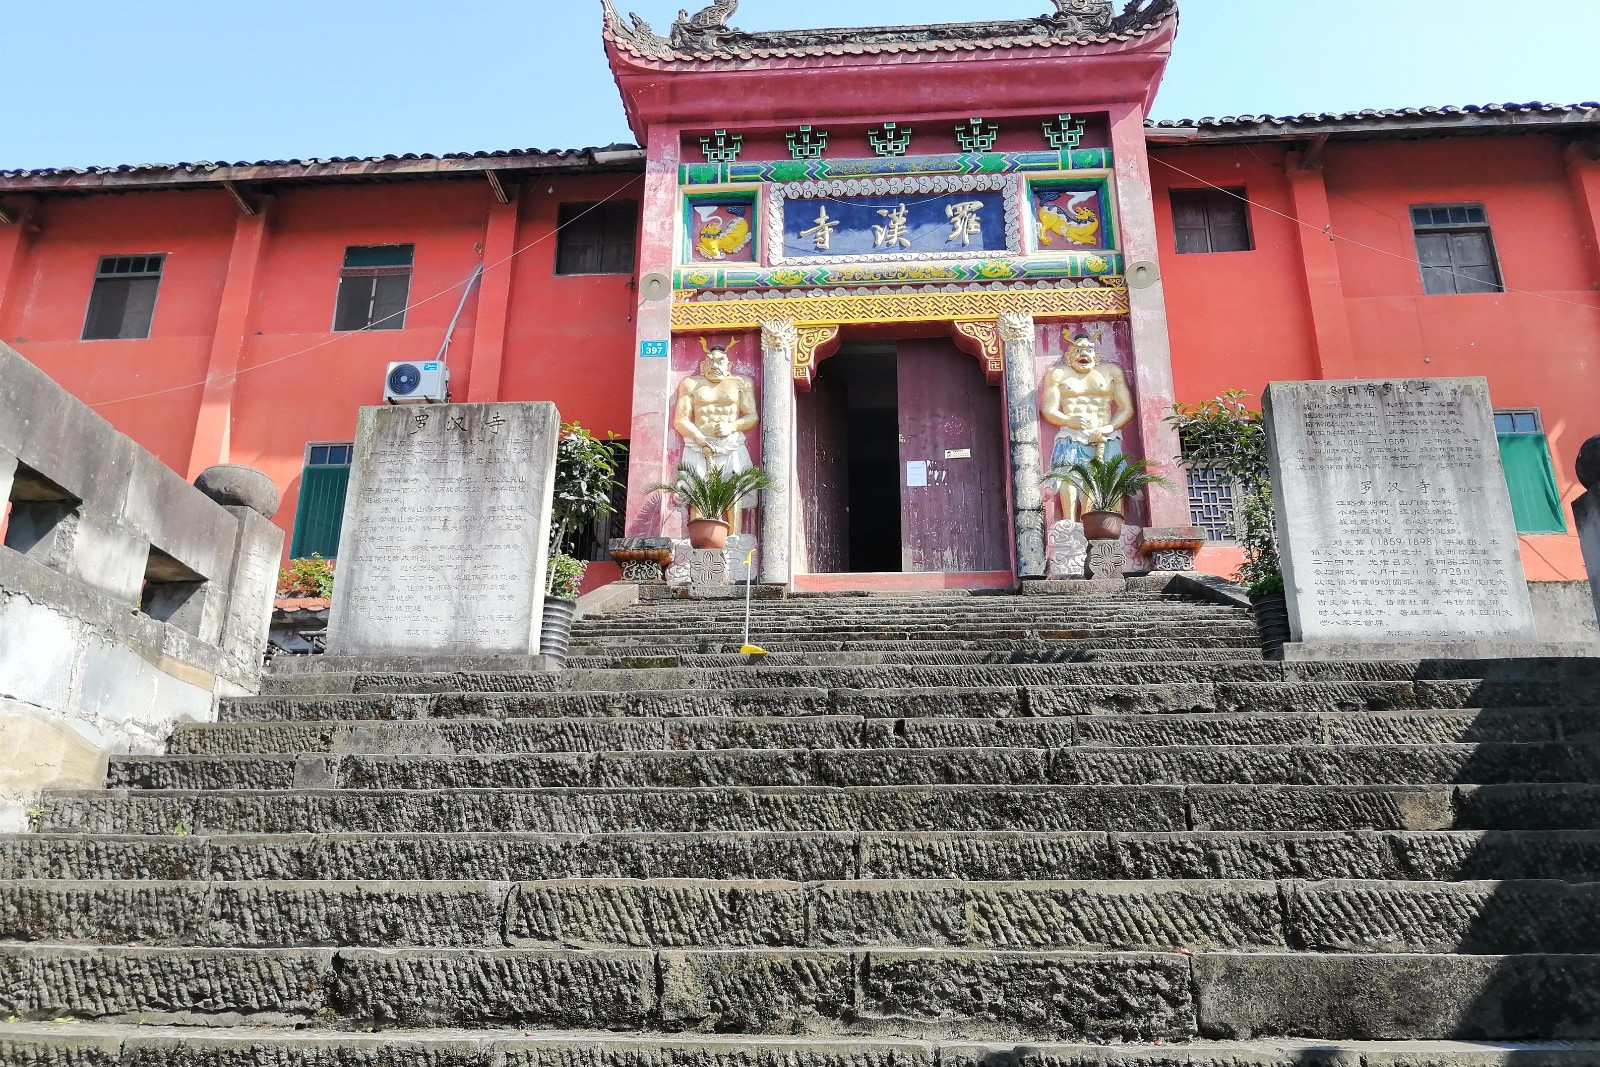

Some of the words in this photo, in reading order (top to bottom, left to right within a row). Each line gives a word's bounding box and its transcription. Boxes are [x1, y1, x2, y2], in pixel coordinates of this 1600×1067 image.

[799, 201, 984, 250] 羅漢寺
[646, 347, 663, 355] 397
[410, 412, 506, 435] 罗汉寺
[1360, 479, 1431, 494] 罗汉寺
